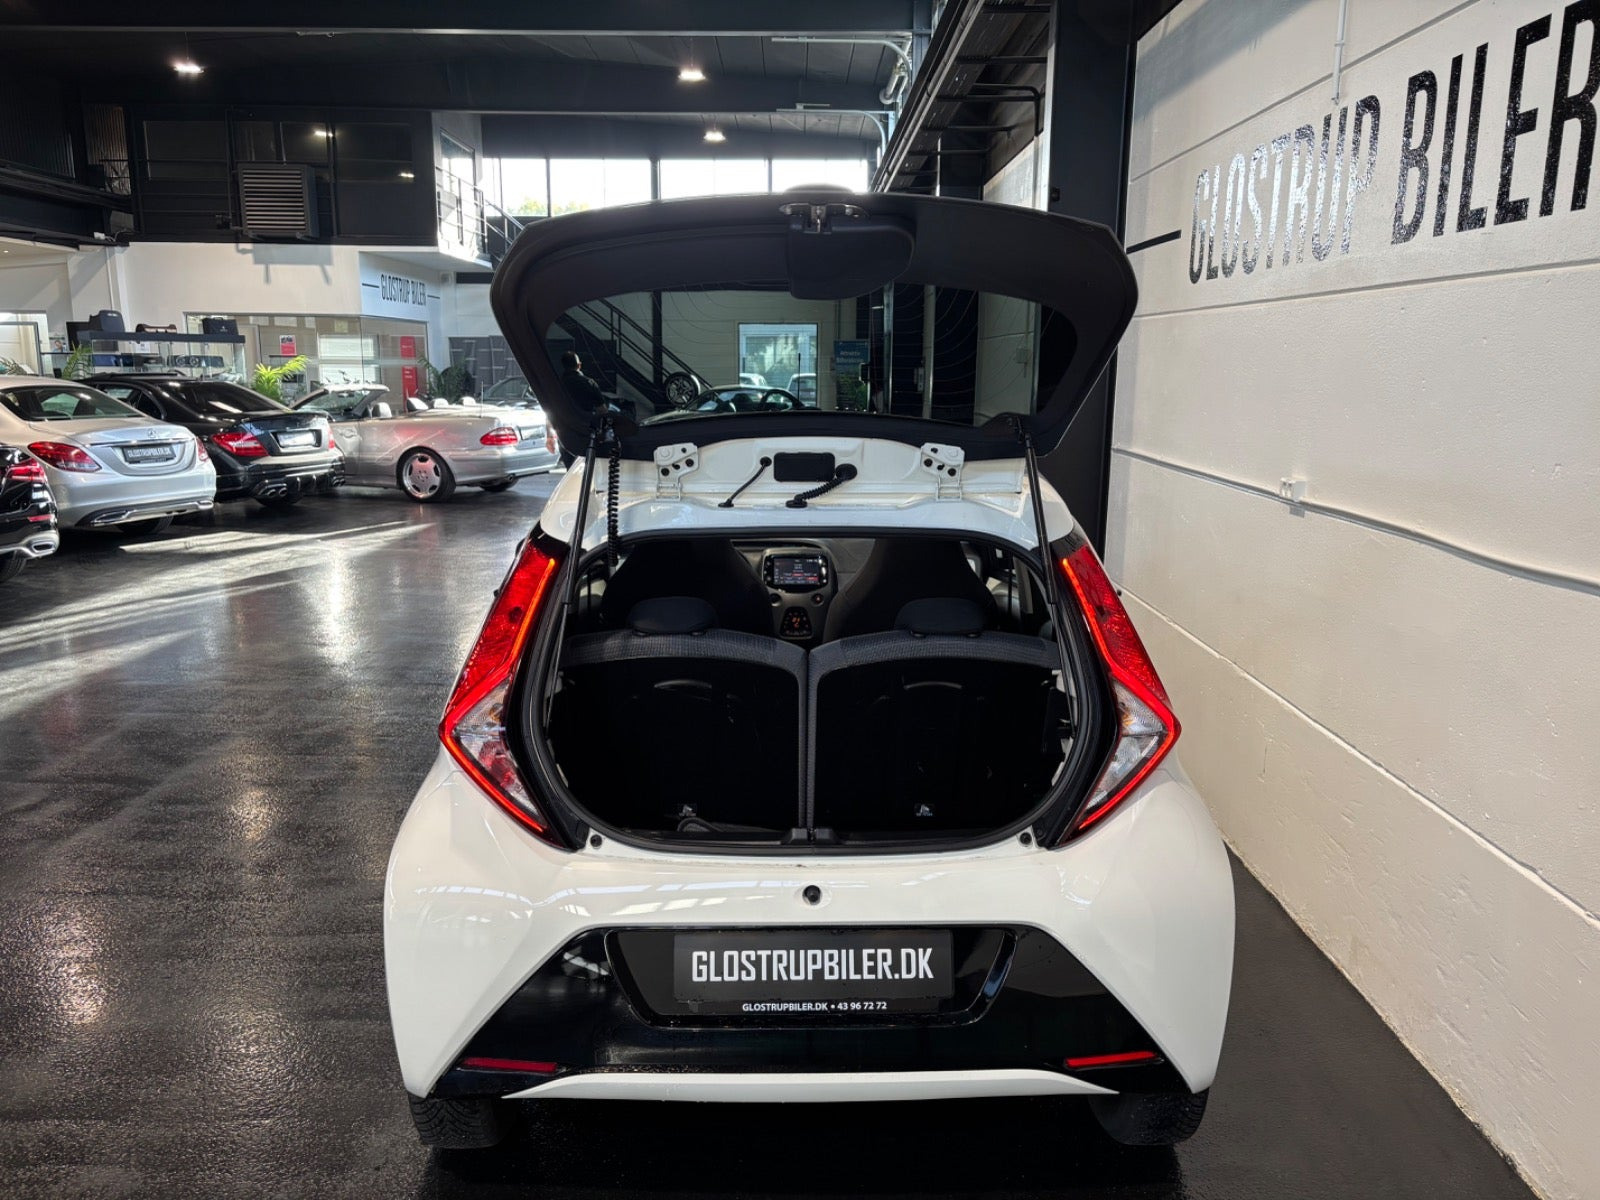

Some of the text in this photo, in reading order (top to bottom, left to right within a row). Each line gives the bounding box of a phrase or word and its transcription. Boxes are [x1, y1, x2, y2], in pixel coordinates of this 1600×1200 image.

[1189, 0, 1600, 284] GLOSTRUP BILER
[691, 948, 934, 982] GLOSTRUPBILER.DK
[742, 1001, 887, 1012] GLOSTRUPBILER.DK 43 96 72 72
